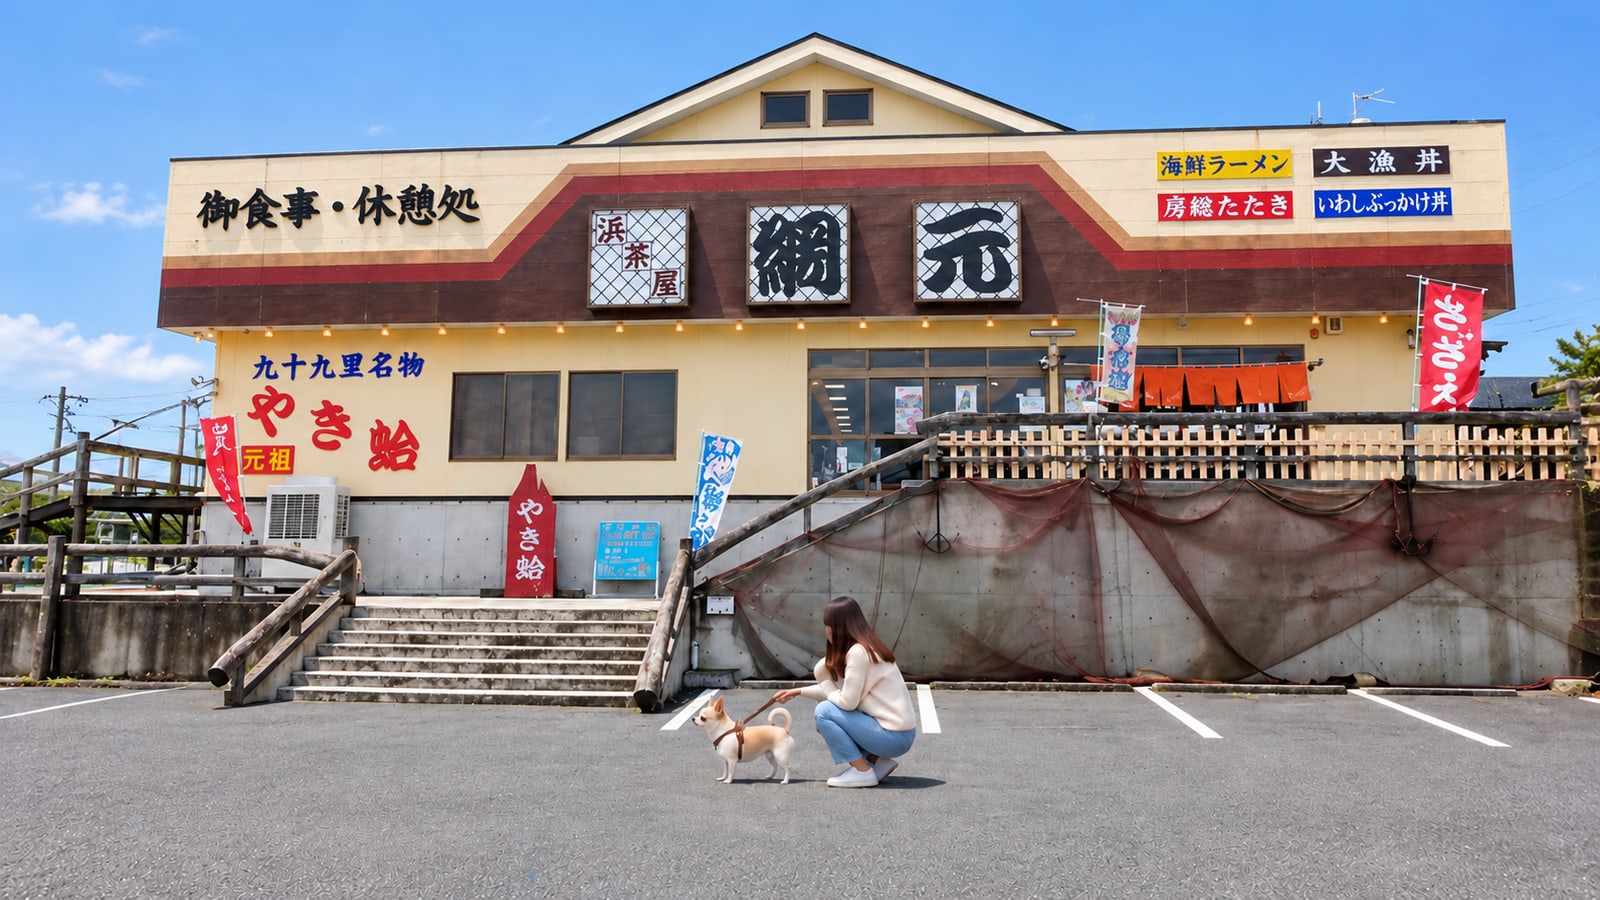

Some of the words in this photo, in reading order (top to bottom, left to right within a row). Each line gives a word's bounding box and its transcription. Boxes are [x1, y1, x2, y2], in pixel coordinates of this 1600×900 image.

[1160, 153, 1289, 177] 海鮮ラーメン
[196, 182, 481, 232] 御食事・休憩処
[1163, 193, 1289, 219] 房総たたき
[1317, 190, 1450, 214] いわしぶっかけ丼
[597, 215, 679, 297] 浜茶屋
[252, 351, 426, 381] 九十九里名物
[246, 384, 421, 472] やき蛤
[242, 447, 292, 472] 元祖
[515, 498, 546, 581] やき蛤
